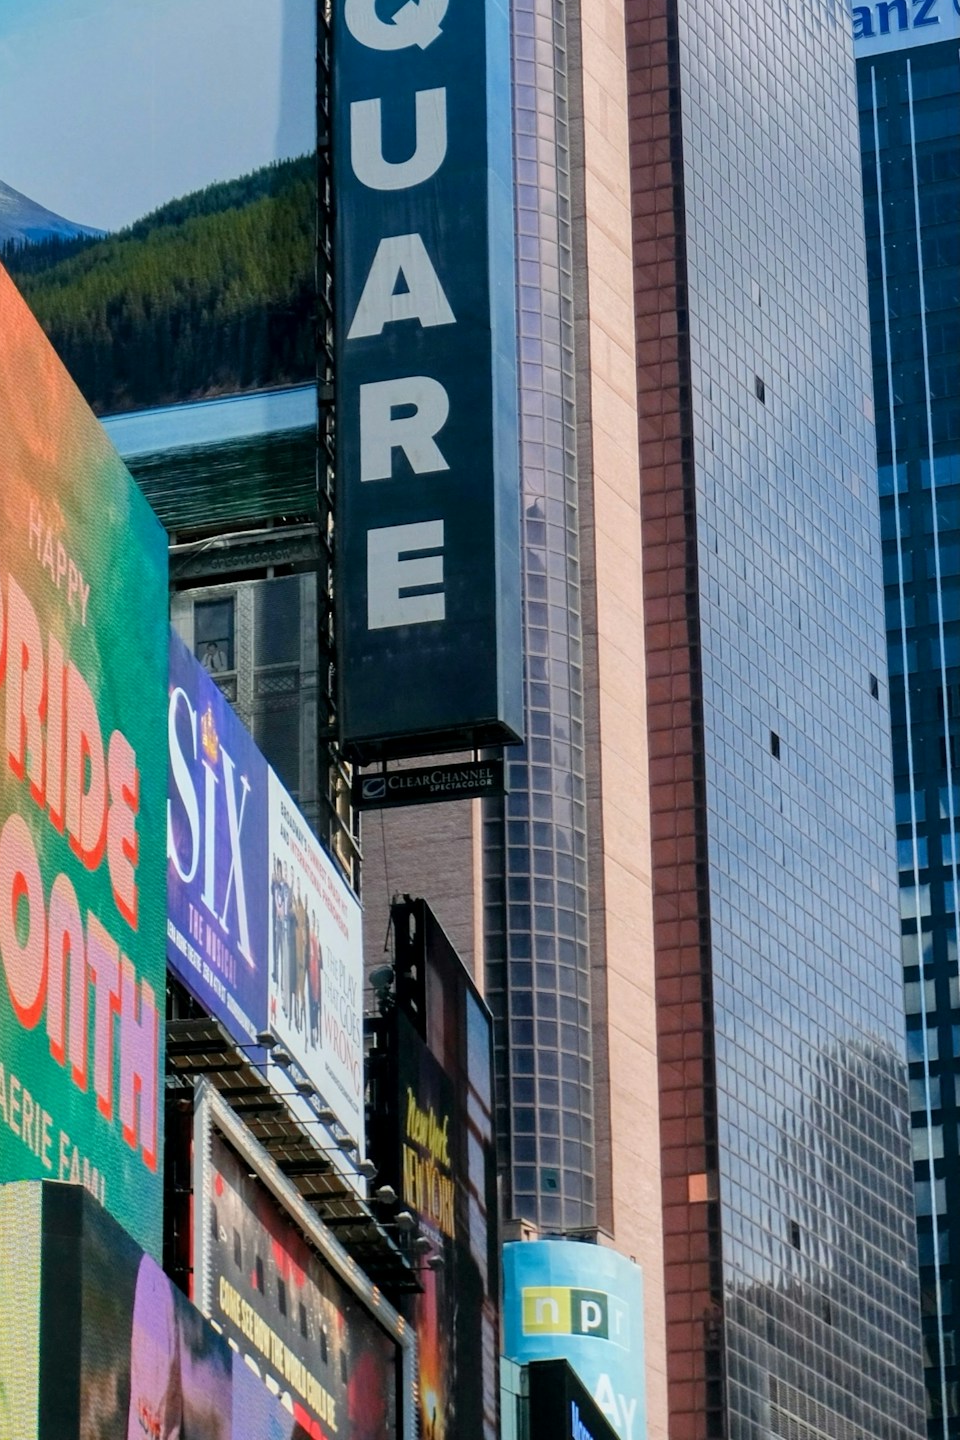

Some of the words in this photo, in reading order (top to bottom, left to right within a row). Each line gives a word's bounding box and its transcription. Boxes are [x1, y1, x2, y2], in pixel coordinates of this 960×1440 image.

[27, 497, 90, 626] HAPPY
[167, 686, 254, 969] SIX
[429, 778, 493, 793] SPECTACOLOR
[188, 902, 204, 947] THE
[205, 923, 238, 990] MUSICAL
[322, 1004, 361, 1098] WRONG
[403, 1142, 426, 1216] NEW
[425, 1158, 456, 1241] YORK
[535, 1296, 624, 1335] npr
